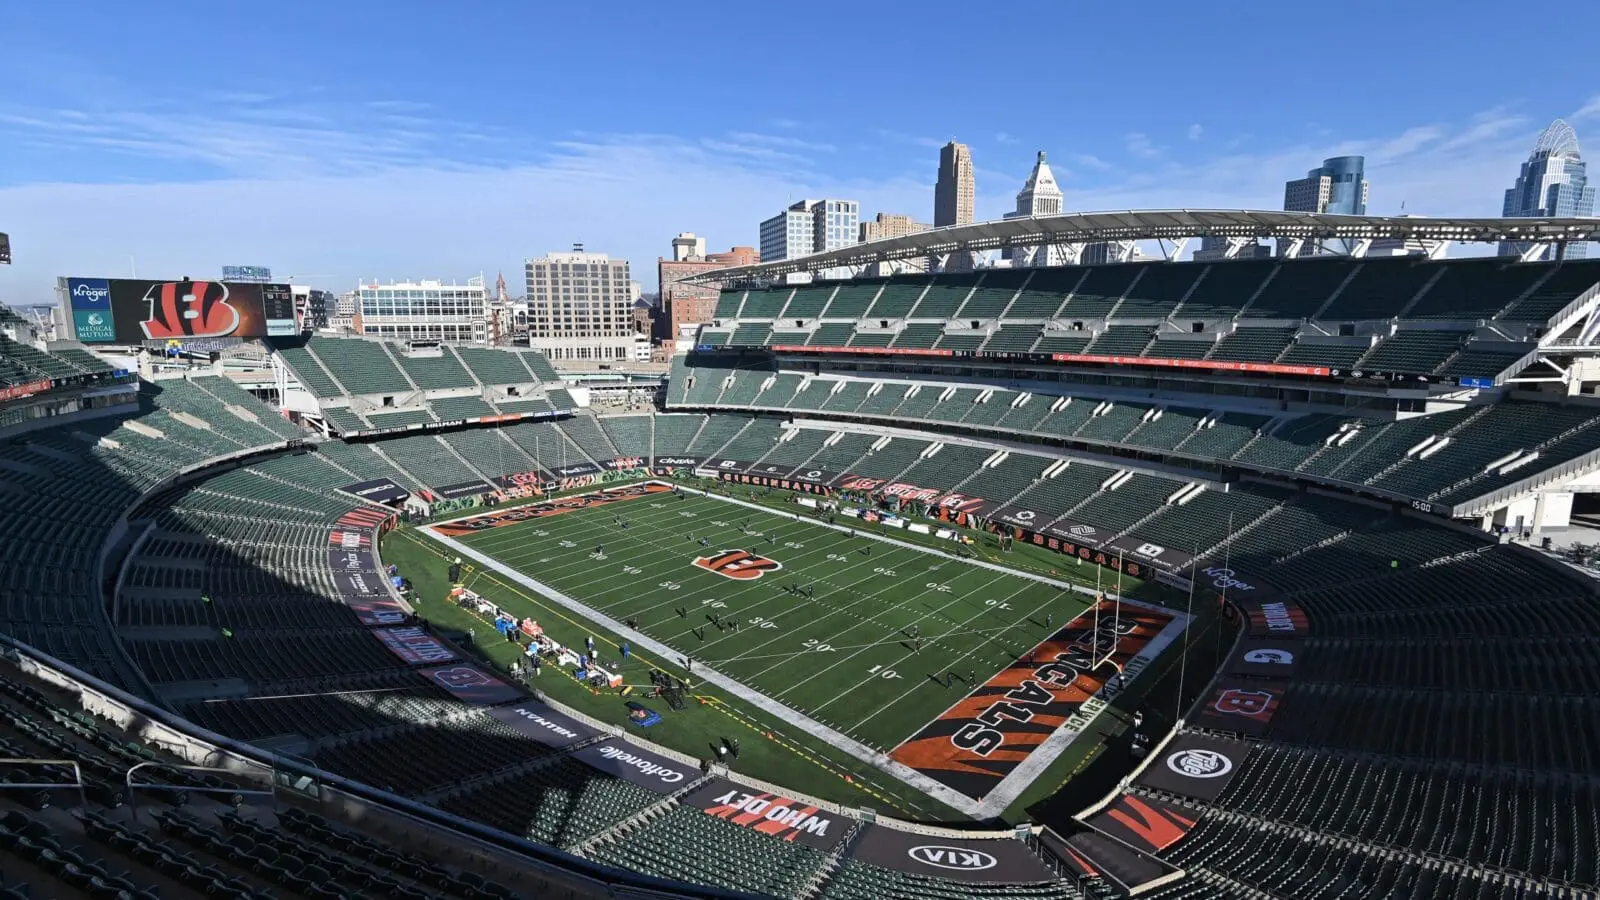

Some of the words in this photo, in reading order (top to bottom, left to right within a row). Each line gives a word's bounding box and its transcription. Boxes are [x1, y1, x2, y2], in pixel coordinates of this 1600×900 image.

[73, 284, 108, 301] Kroger
[426, 420, 463, 429] HILLMAN
[723, 473, 820, 494] CINCINNATI
[1033, 533, 1140, 577] BENGALS
[1202, 566, 1255, 591] Kroger
[749, 617, 776, 629] 30
[802, 638, 832, 652] 20
[868, 664, 898, 679] 10
[951, 615, 1137, 758] BENGALS
[515, 708, 578, 739] HILLMAN
[600, 745, 684, 783] Cottonelle
[713, 789, 765, 815] DEY
[767, 806, 831, 837] WHO
[924, 848, 983, 868] KIA
